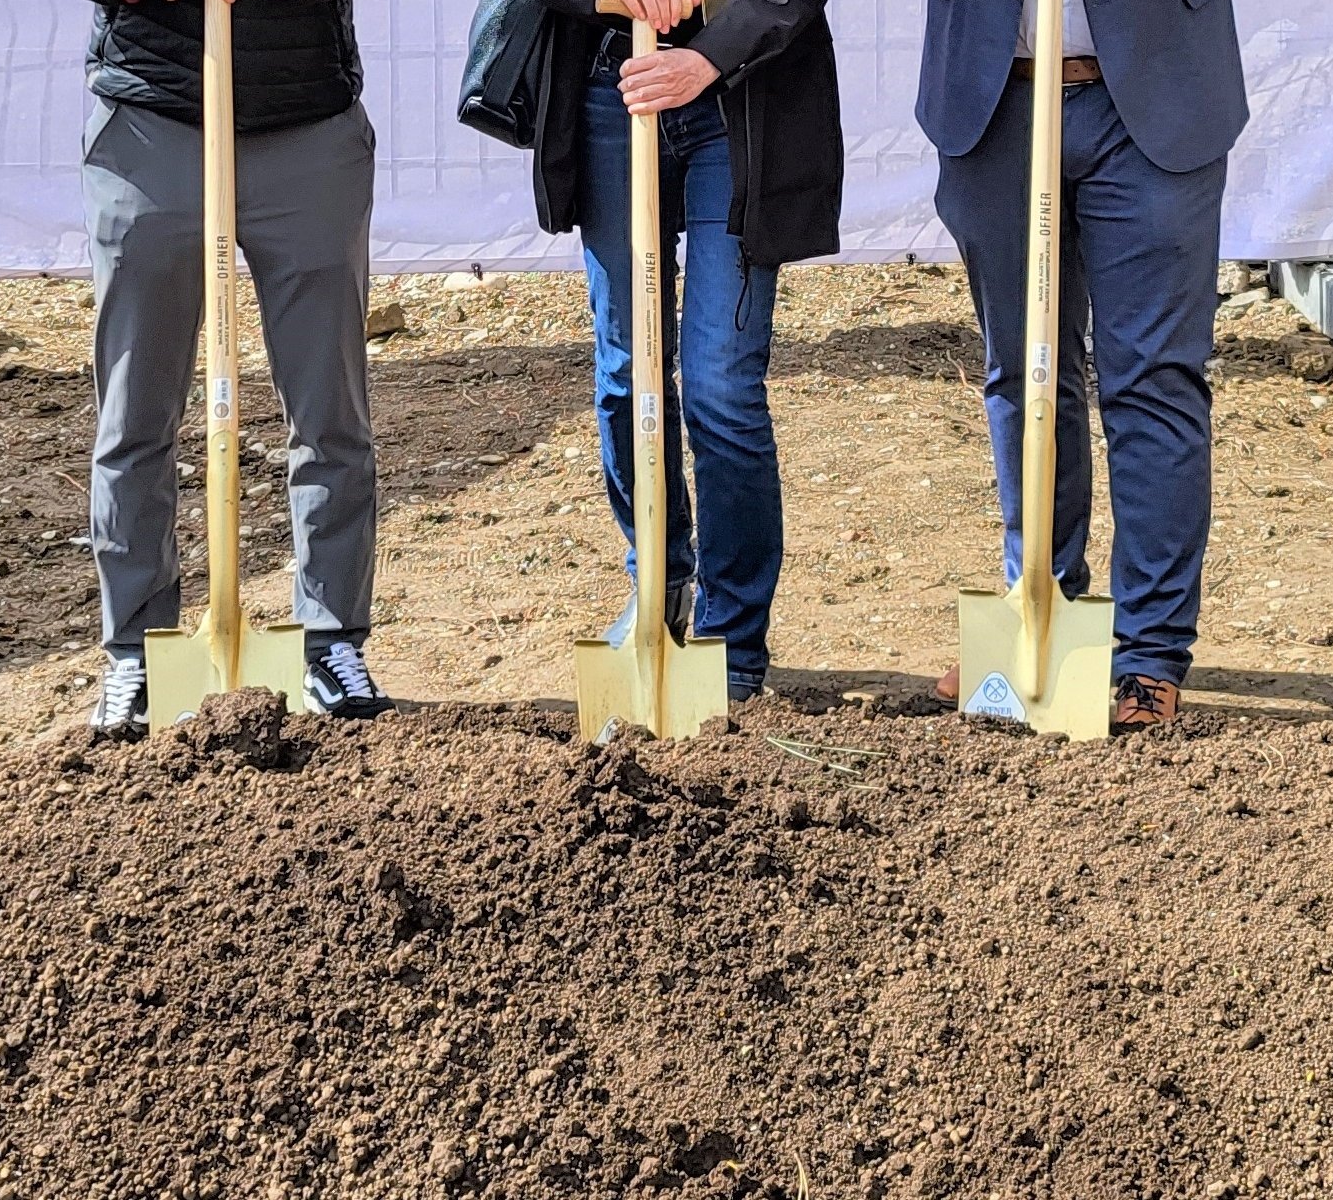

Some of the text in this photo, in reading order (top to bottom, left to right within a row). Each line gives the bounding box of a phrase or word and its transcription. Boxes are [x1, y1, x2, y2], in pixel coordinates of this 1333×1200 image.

[1040, 192, 1051, 236] OFFNER
[217, 235, 229, 279] OFFNER
[645, 252, 656, 294] OFFNER
